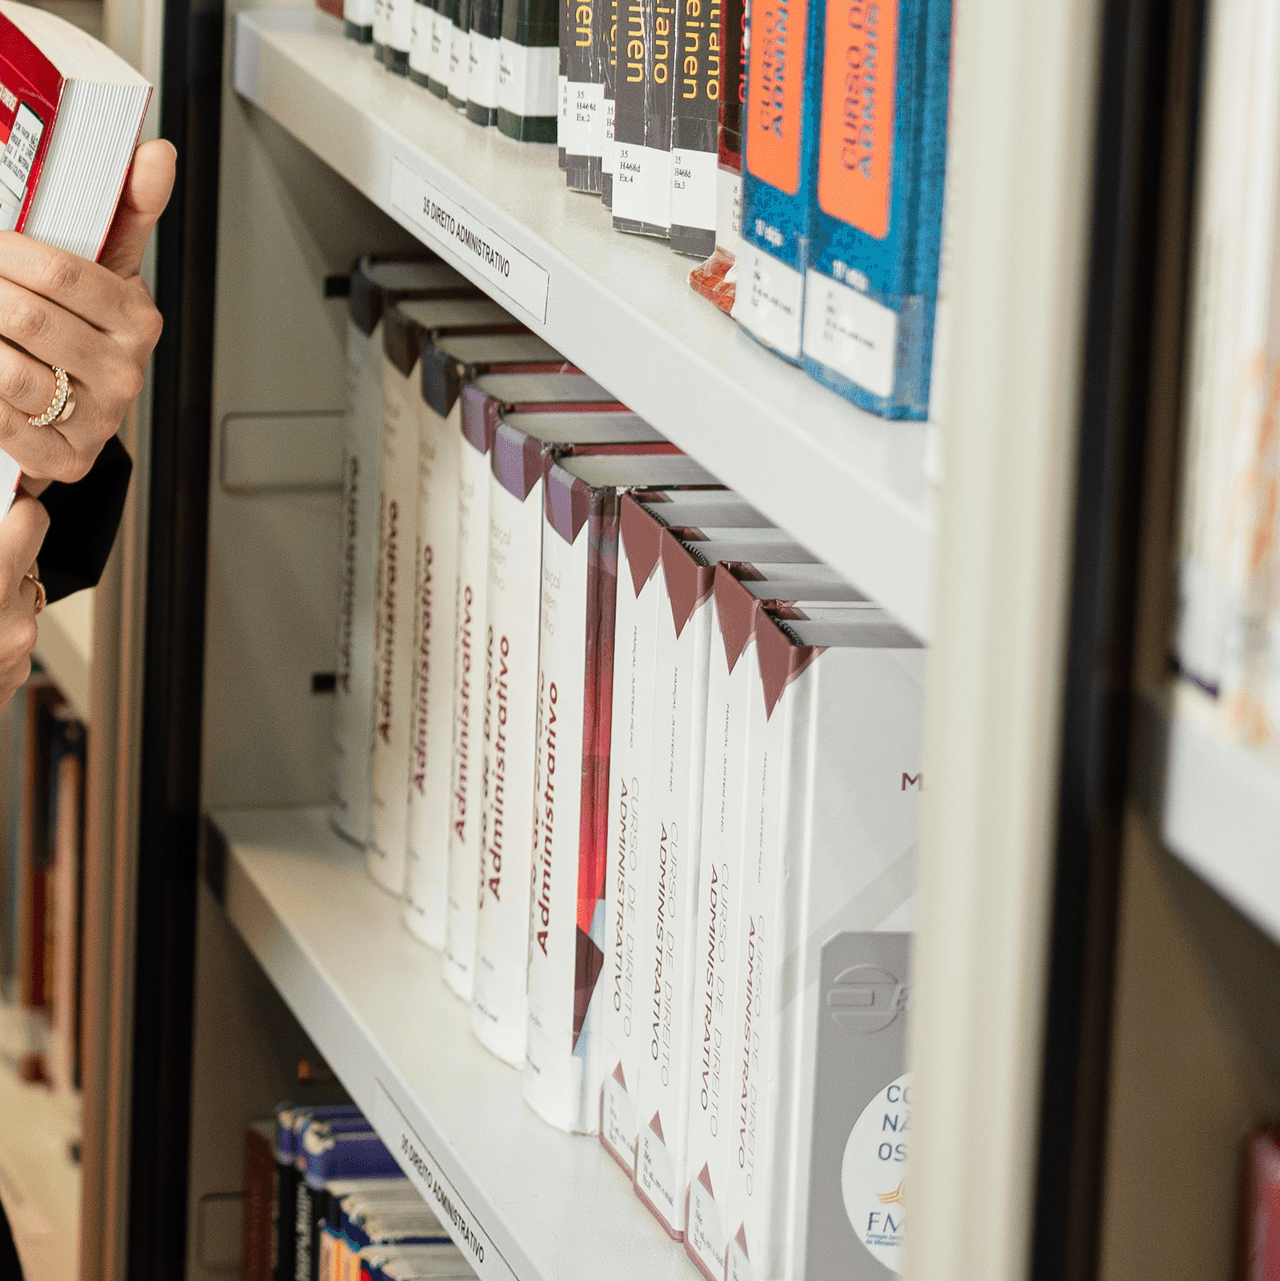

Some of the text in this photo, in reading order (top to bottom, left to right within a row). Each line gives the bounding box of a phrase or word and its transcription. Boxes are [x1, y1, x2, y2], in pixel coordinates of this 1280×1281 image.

[576, 90, 585, 99] 35
[576, 113, 590, 122] Ex.2
[619, 161, 641, 173] H468d
[619, 173, 634, 183] Ex.4
[620, 149, 629, 159] 35
[674, 155, 682, 164] 35
[674, 180, 686, 190] Ex.3
[759, 9, 774, 133] CURSO
[841, 44, 862, 172] CURSO
[423, 196, 510, 278] 35 DIREITO ADMINISTRATIVO
[411, 544, 433, 797] Administrativo
[453, 584, 474, 844] Administrativo
[488, 634, 510, 902] Administrativo
[536, 680, 559, 958] Administrativo
[613, 777, 629, 1013] ADMINISTRATIVO
[623, 775, 640, 1038] CURSO DE DIREITO
[651, 820, 669, 1062] ADMINISTRATIVO
[661, 820, 679, 1088] CURSO DE DIREITO
[700, 862, 719, 1111] ADMINISTRATIVO
[710, 862, 730, 1138] CURSO DE DIREITO
[738, 914, 756, 1170] ADMINISTRATIVO
[745, 914, 766, 1197] CURSO DE DIREITO
[432, 1180, 485, 1264] ADMINISTRATIVO
